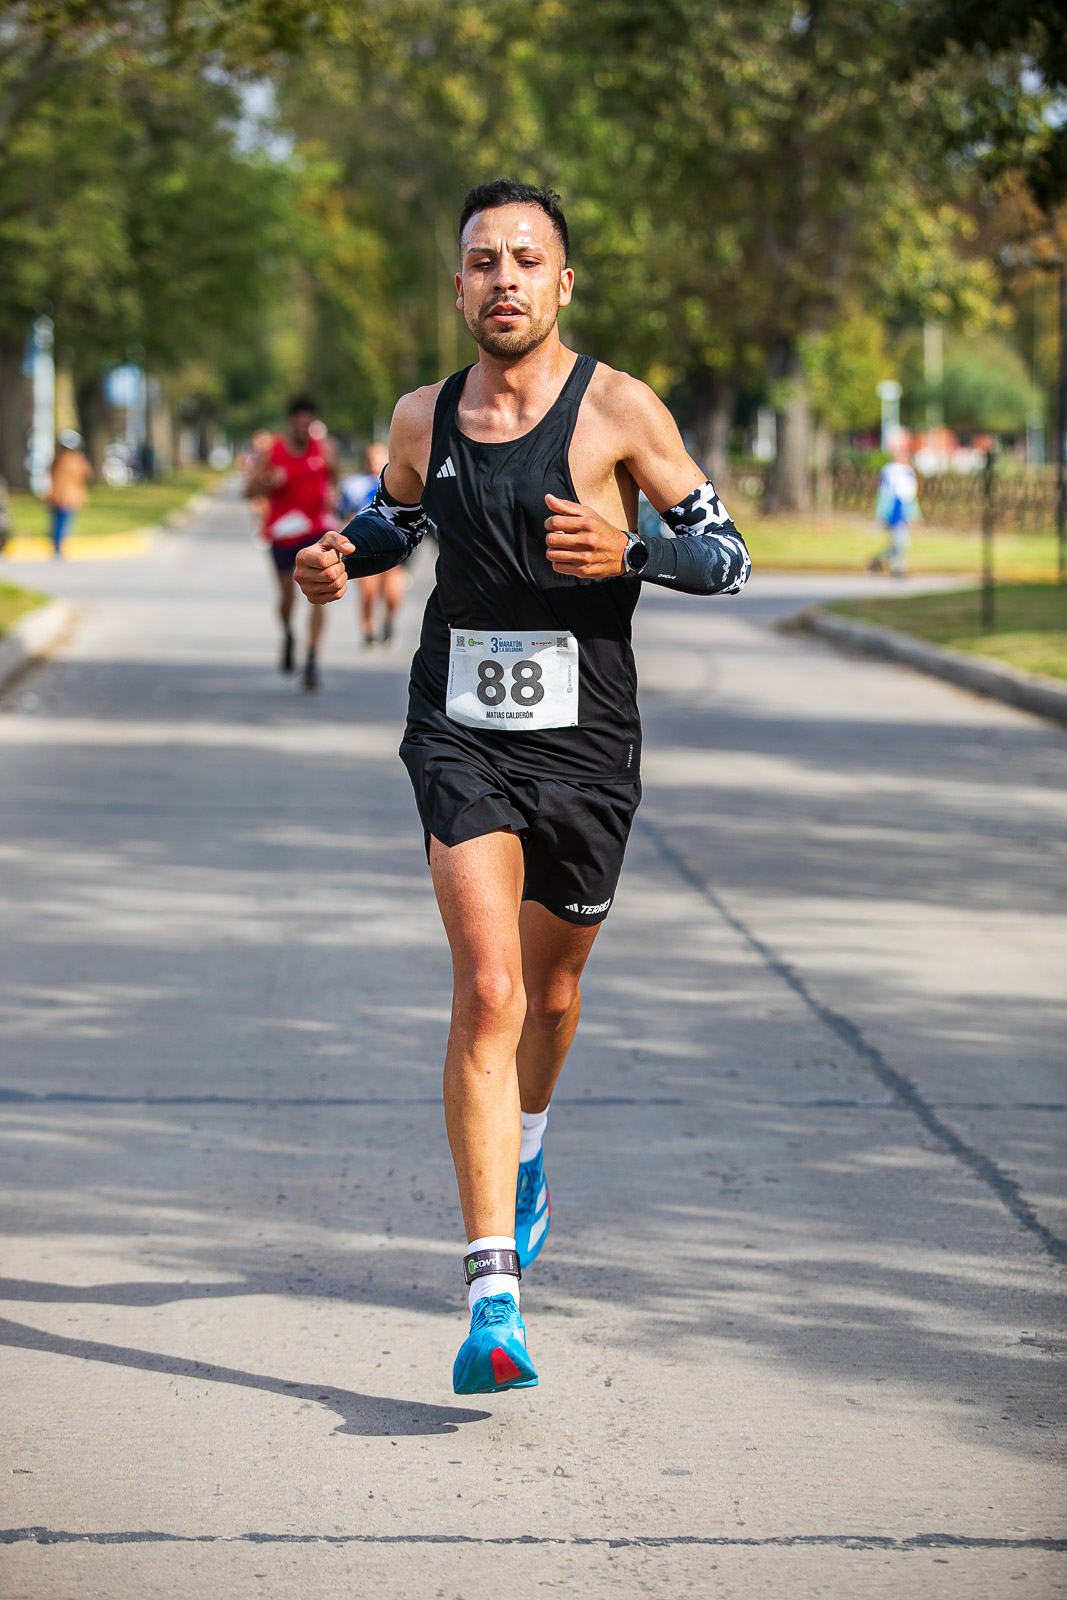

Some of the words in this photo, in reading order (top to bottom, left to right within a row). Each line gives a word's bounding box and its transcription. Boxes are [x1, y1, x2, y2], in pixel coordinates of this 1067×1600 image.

[490, 636, 499, 654] 3
[476, 659, 545, 707] 88
[486, 711, 505, 719] MATIAS
[505, 710, 534, 720] CALDERÓN
